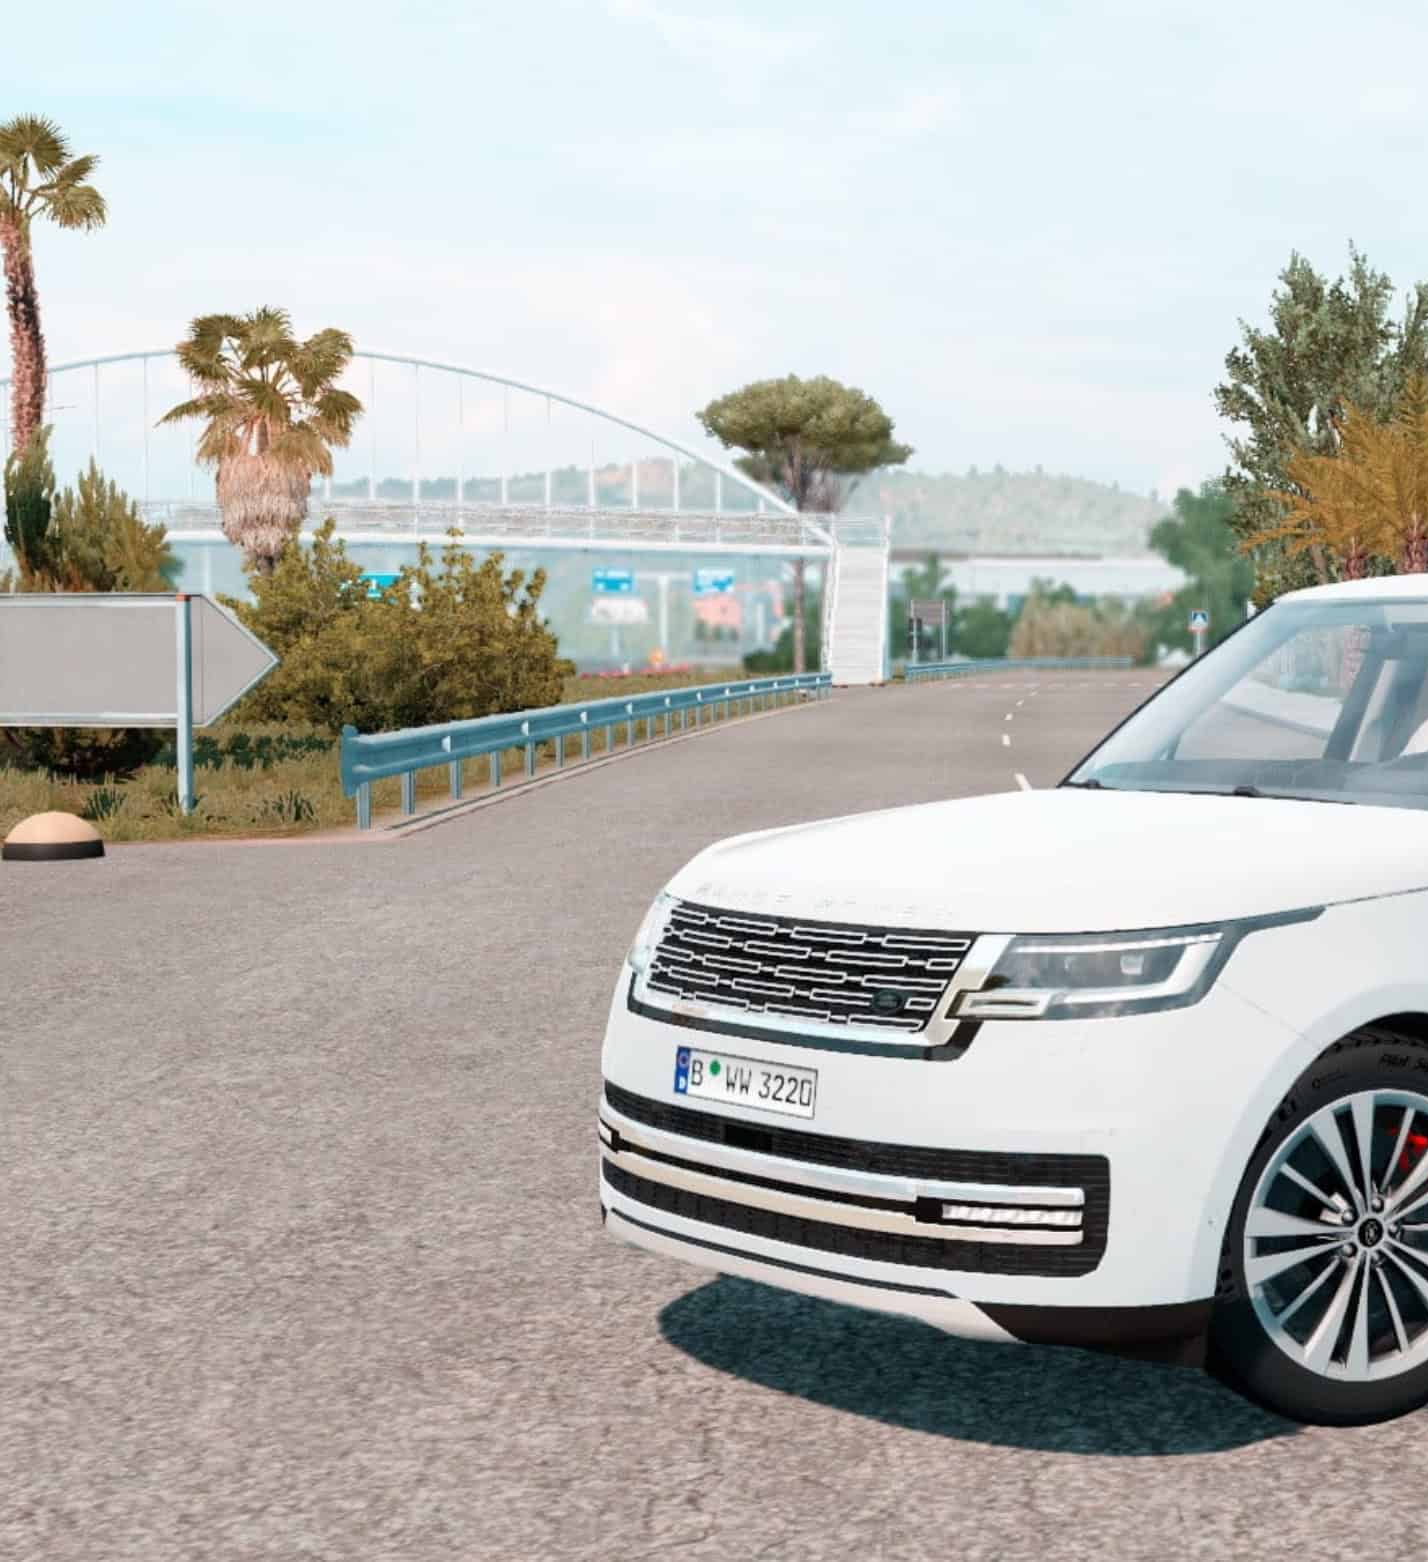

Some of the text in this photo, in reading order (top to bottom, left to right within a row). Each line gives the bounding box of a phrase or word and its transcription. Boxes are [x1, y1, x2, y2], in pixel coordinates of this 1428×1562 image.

[691, 1059, 704, 1087] B
[726, 1064, 752, 1095] WW
[758, 1071, 812, 1107] 3220
